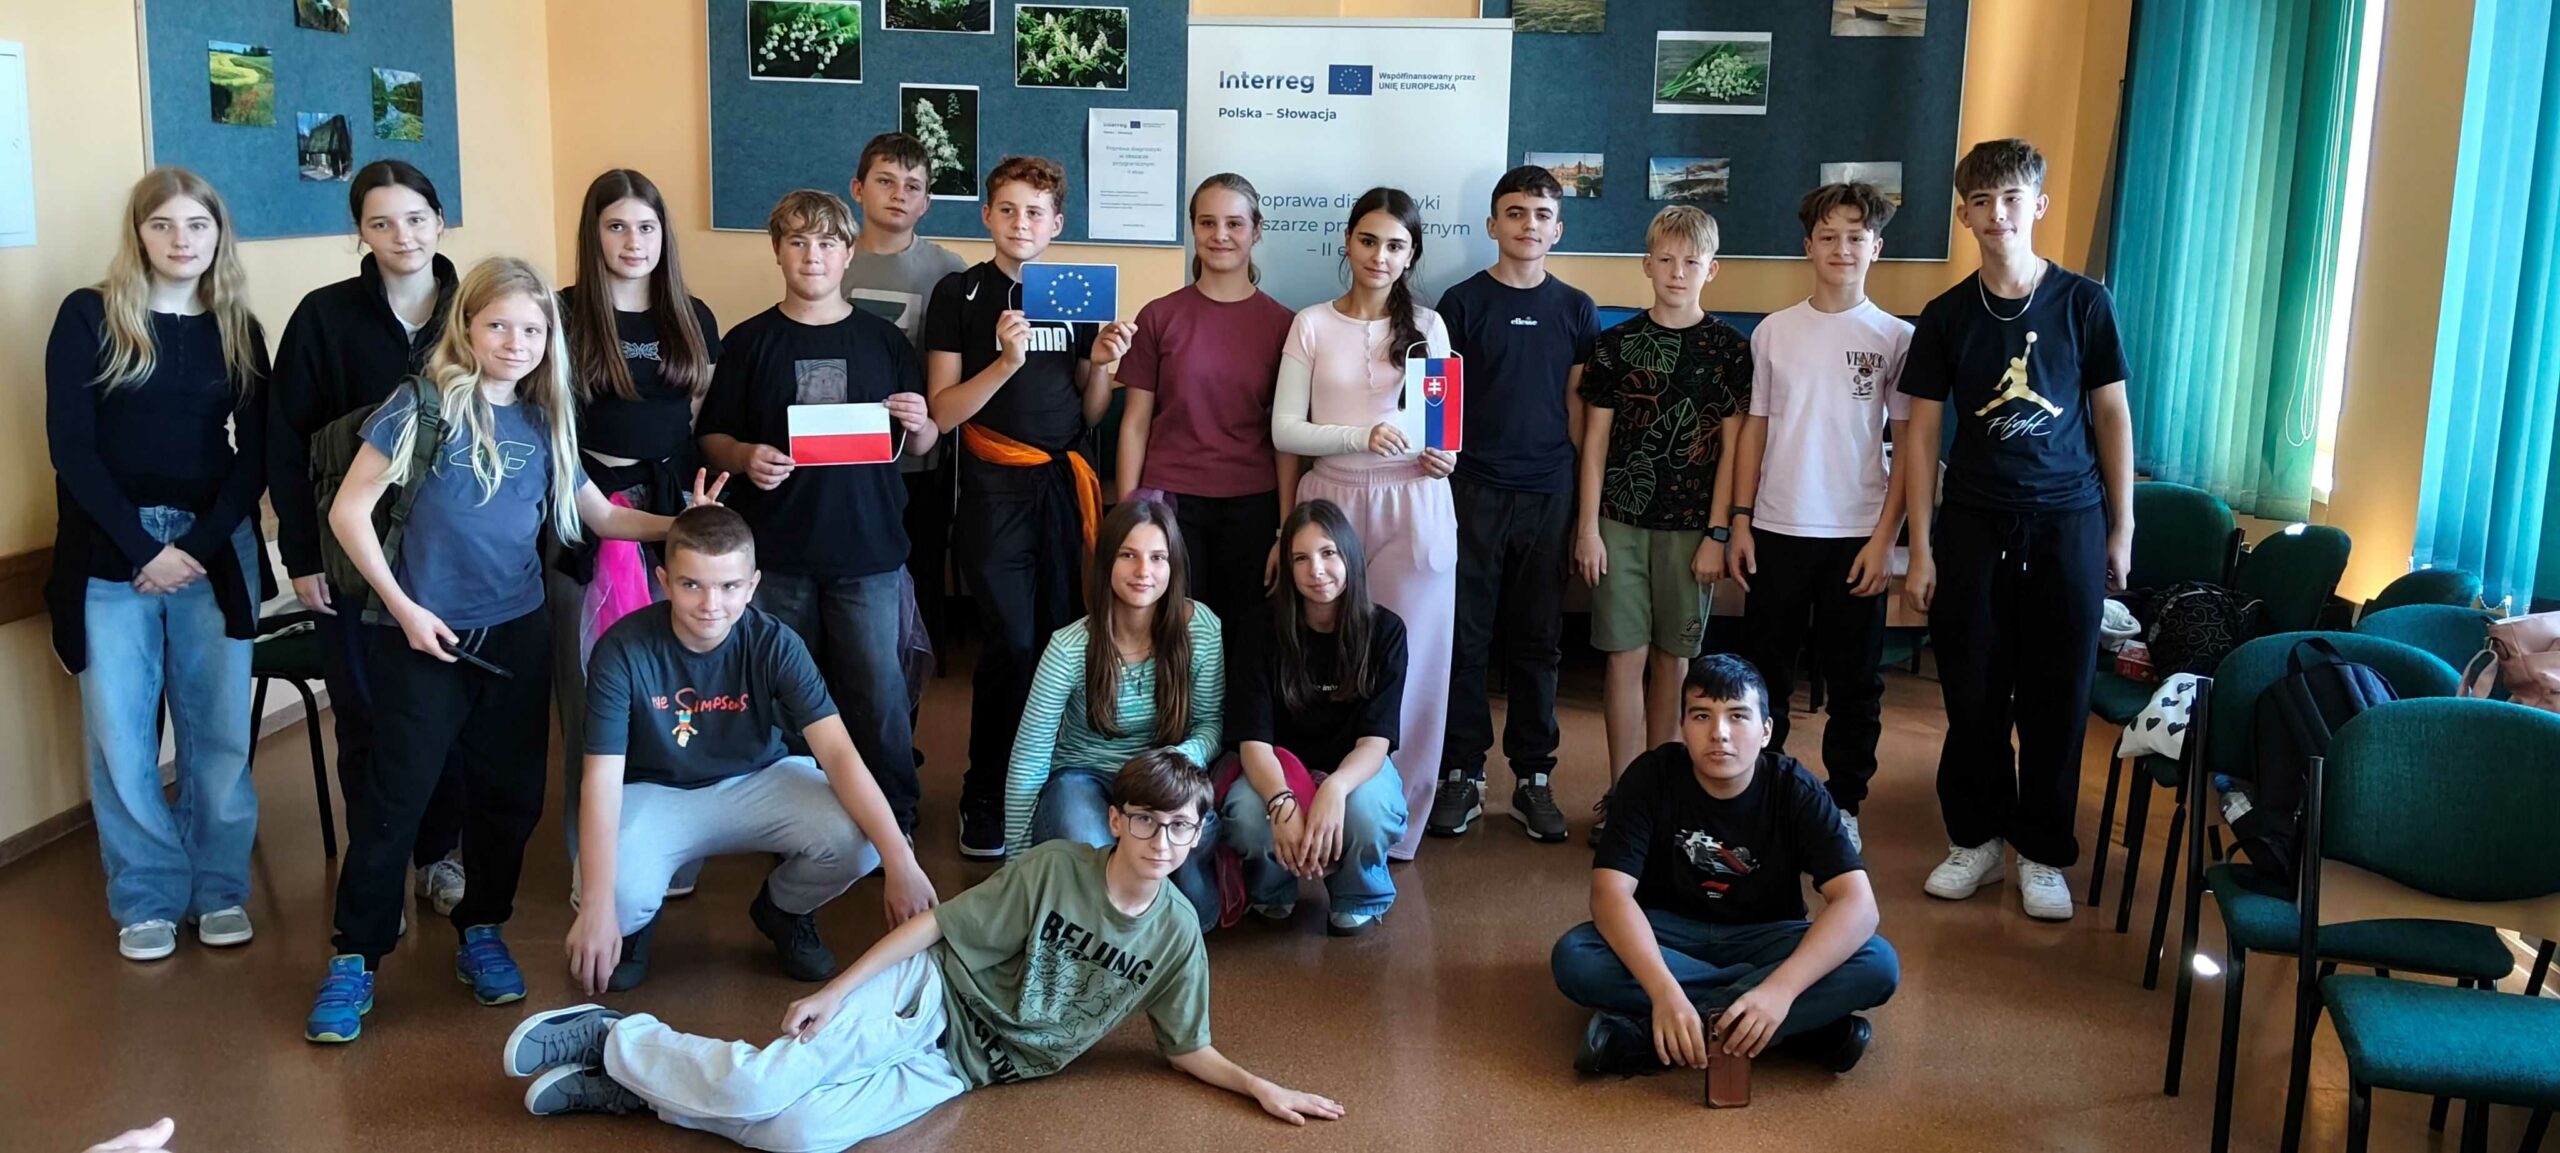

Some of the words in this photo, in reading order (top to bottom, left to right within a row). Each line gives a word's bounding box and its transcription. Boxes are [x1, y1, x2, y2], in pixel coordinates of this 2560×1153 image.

[1219, 70, 1315, 94] Interreg
[1379, 72, 1453, 82] Współfinansowany
[1379, 82, 1398, 91] UNIĘ
[1400, 82, 1457, 92] EUROPEJSKĄ
[1218, 107, 1263, 119] Polska
[1276, 108, 1337, 122] Słowacja
[1986, 409, 2052, 440] Flight
